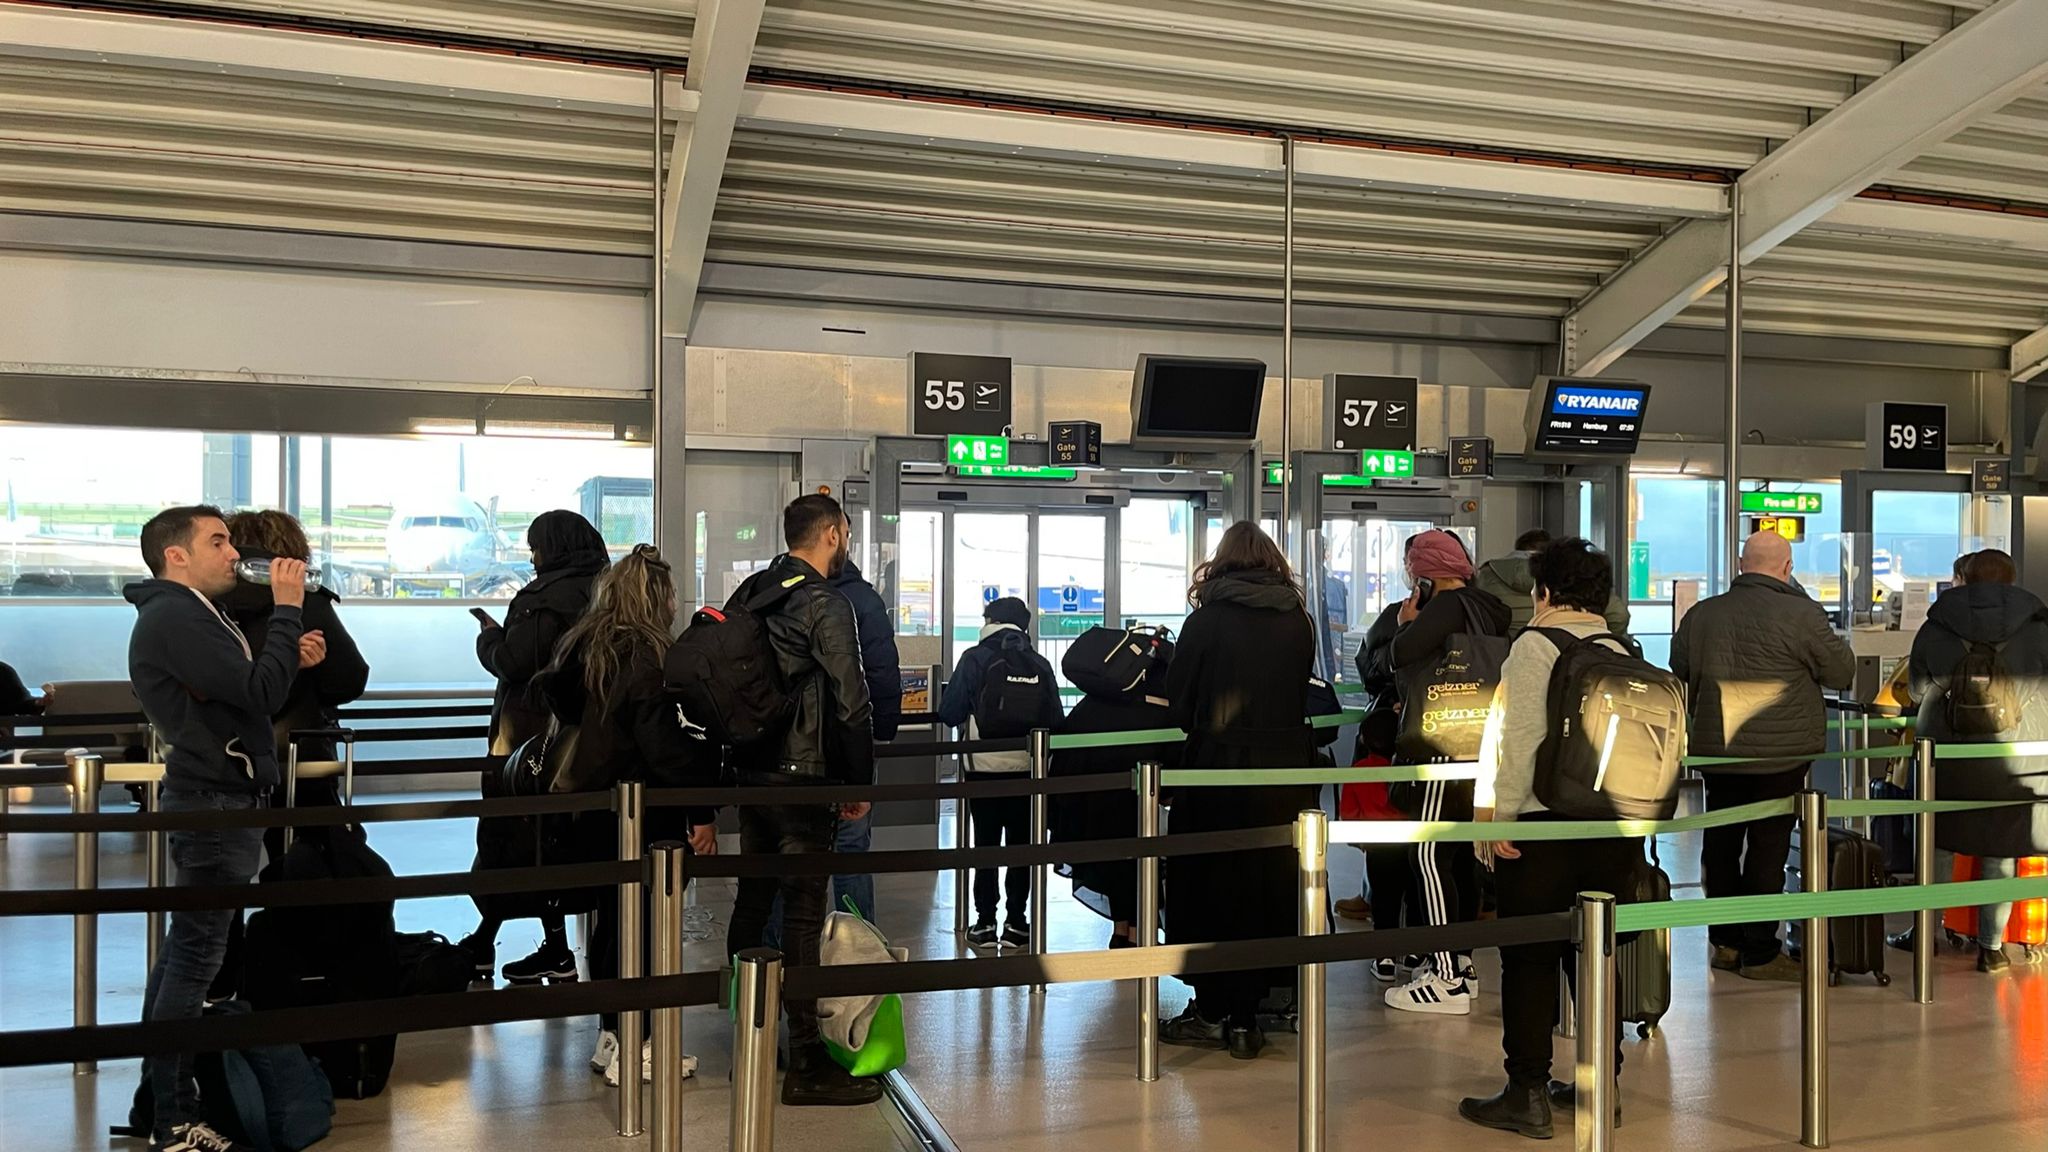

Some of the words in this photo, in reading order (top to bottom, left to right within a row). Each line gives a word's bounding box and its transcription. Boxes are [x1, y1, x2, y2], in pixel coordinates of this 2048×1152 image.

[924, 379, 966, 411] 55
[1567, 395, 1639, 410] RYANAIR
[1342, 399, 1378, 428] 57
[1583, 422, 1608, 431] Hamburg
[1888, 424, 1918, 450] 59
[1057, 443, 1077, 452] Gate
[1061, 453, 1072, 461] 55
[1457, 457, 1478, 465] Gate
[1462, 465, 1473, 473] 57
[1985, 482, 1998, 490] 59
[1427, 681, 1480, 700] getzner
[1422, 706, 1490, 733] getzner
